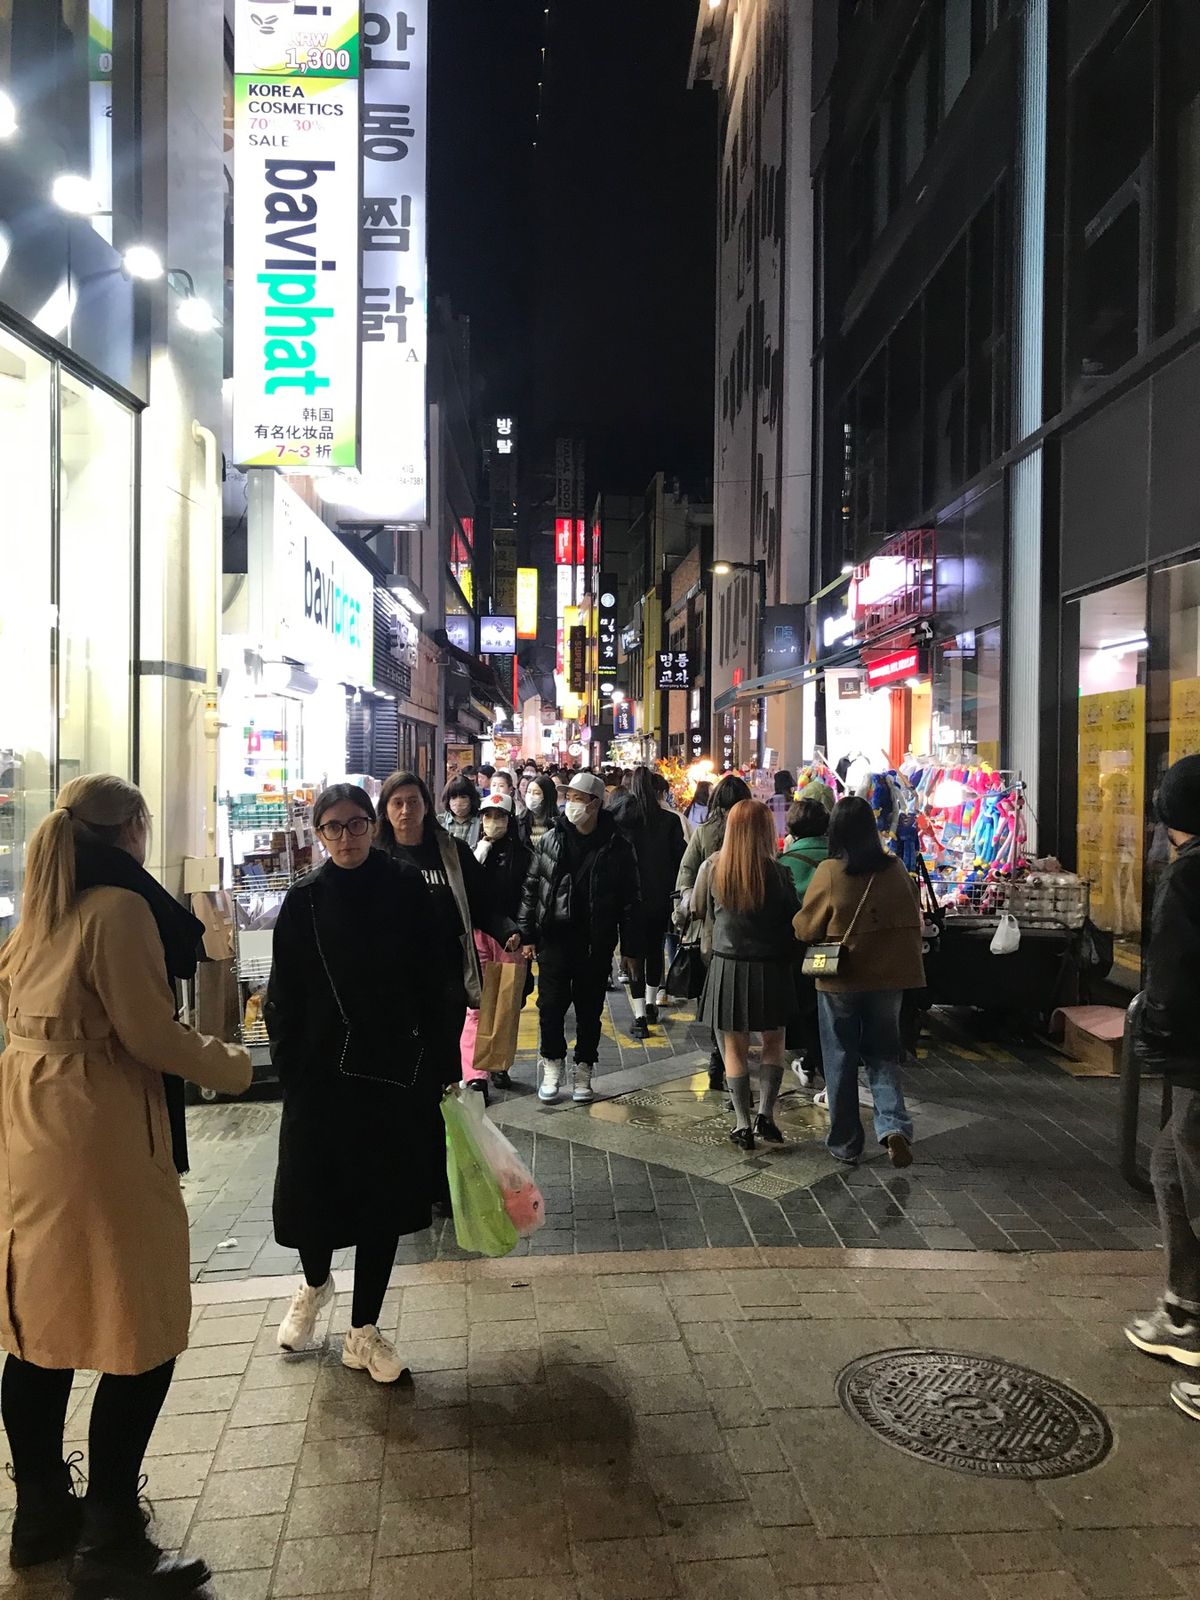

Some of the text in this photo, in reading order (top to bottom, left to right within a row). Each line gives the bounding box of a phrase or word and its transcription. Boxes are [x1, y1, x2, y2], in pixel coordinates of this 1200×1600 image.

[285, 47, 350, 74] 1,300
[248, 83, 305, 98] KOREA
[248, 101, 344, 117] COSMETICS
[248, 134, 289, 148] SALE
[256, 158, 337, 396] baviphat
[302, 407, 334, 422] 韩国
[254, 424, 334, 440] 有名化妆品
[275, 443, 332, 459] 7~3 折
[659, 652, 690, 668] 명동
[659, 669, 689, 684] 교자
